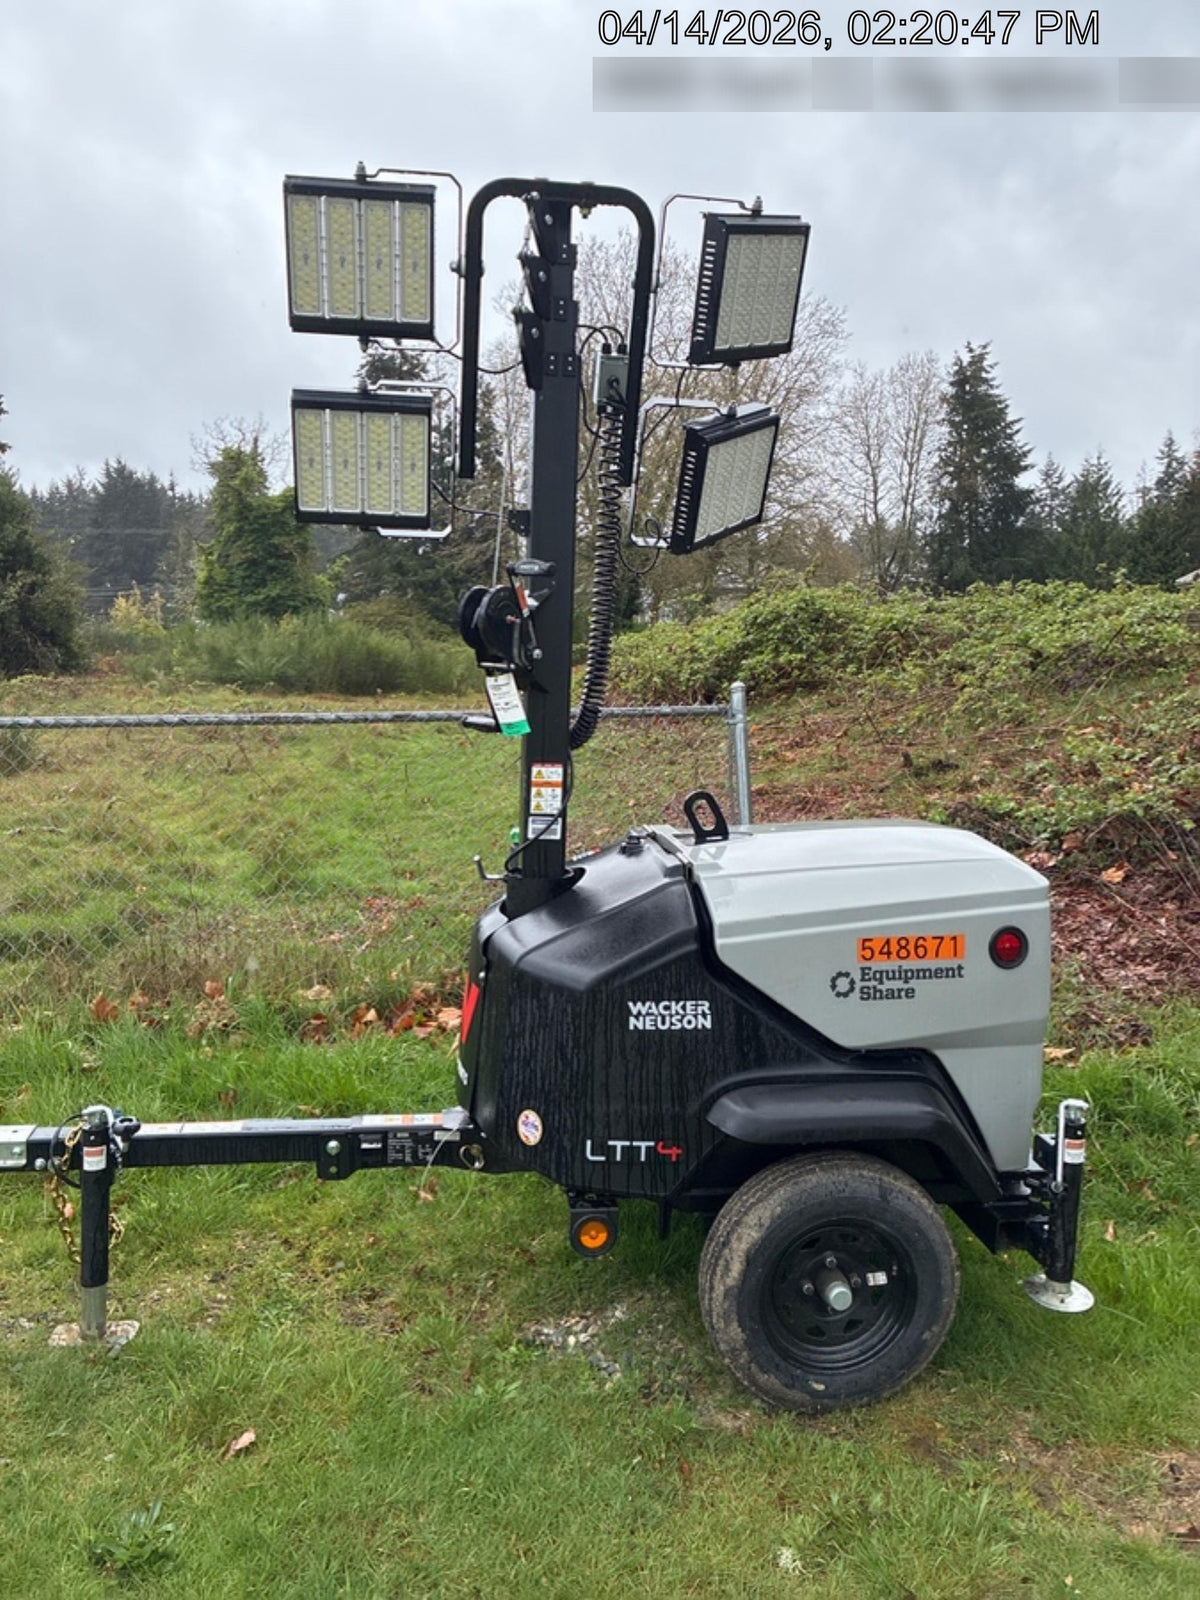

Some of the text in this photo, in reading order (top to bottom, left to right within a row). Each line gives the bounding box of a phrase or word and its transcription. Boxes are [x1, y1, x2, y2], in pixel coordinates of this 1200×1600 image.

[860, 936, 959, 961] 548671
[859, 963, 964, 984] Equipment
[859, 984, 916, 1001] Share
[627, 1000, 711, 1015] WACKER
[628, 1015, 712, 1030] NEUSON
[586, 1139, 683, 1162] LTT4
